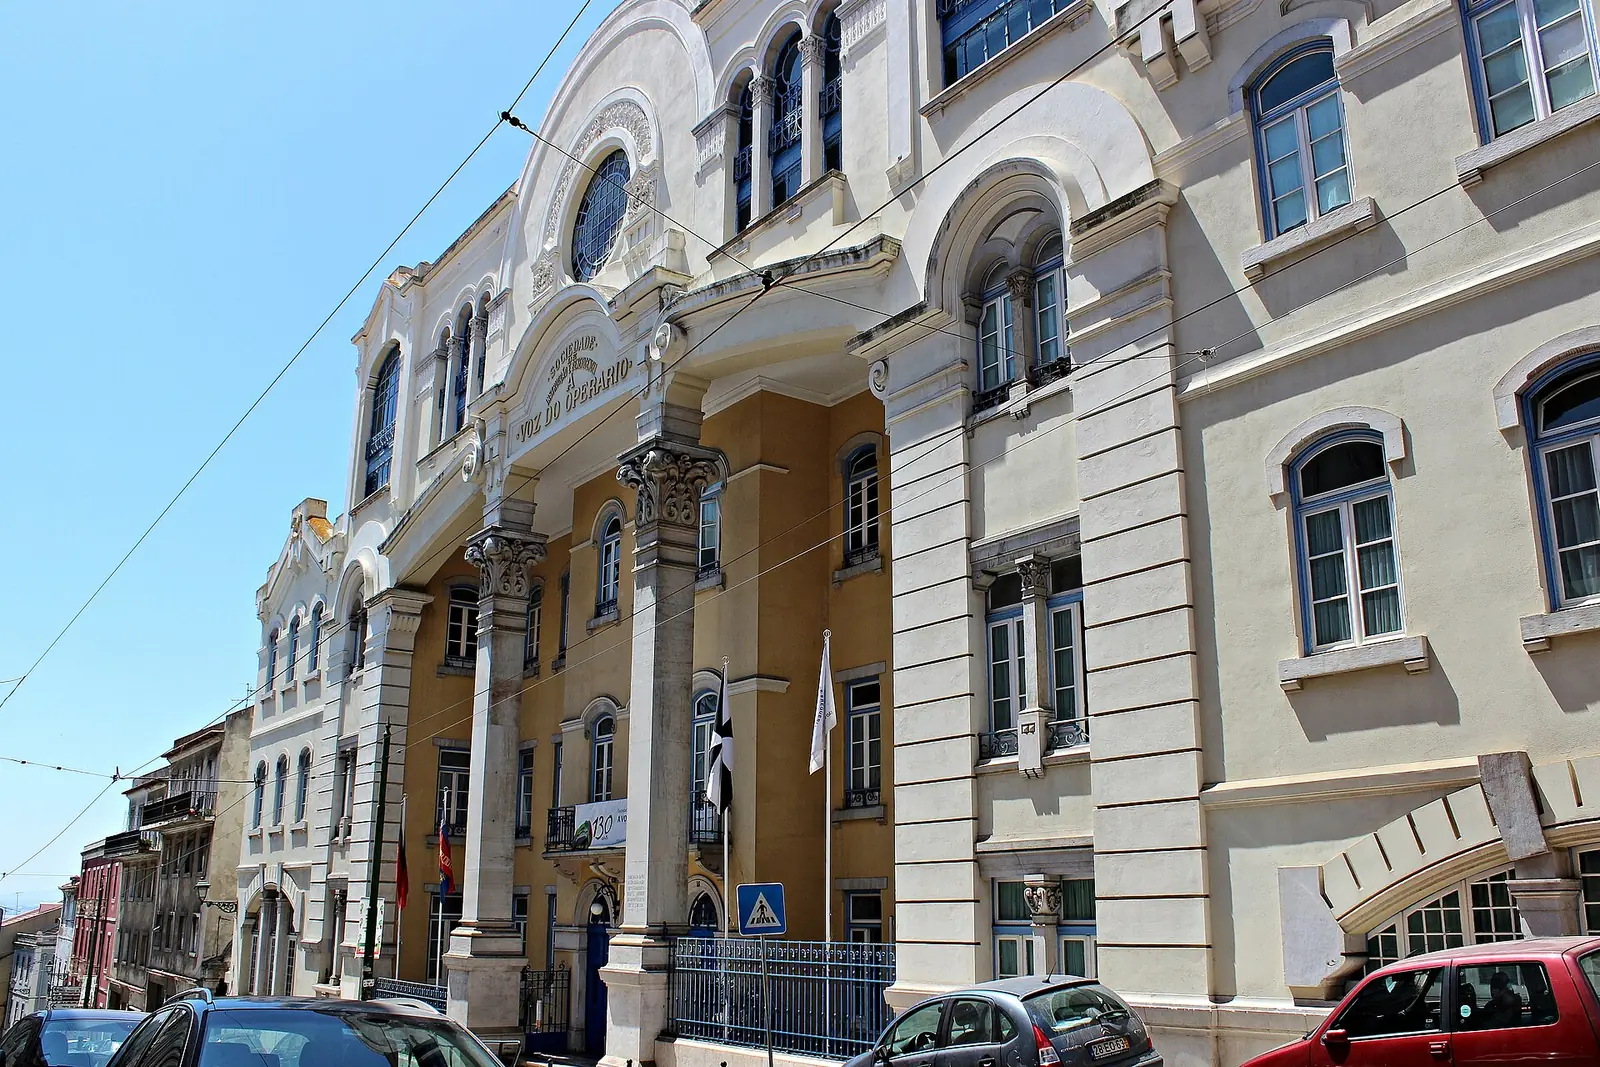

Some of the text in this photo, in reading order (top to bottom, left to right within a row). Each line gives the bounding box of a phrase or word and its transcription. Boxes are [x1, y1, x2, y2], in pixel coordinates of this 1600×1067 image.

[550, 336, 596, 378] SOCIEDADE
[520, 411, 542, 442] VOZ
[544, 400, 561, 427] DO
[565, 357, 629, 412] OPERARIO
[566, 373, 576, 392] A
[592, 814, 613, 840] 130
